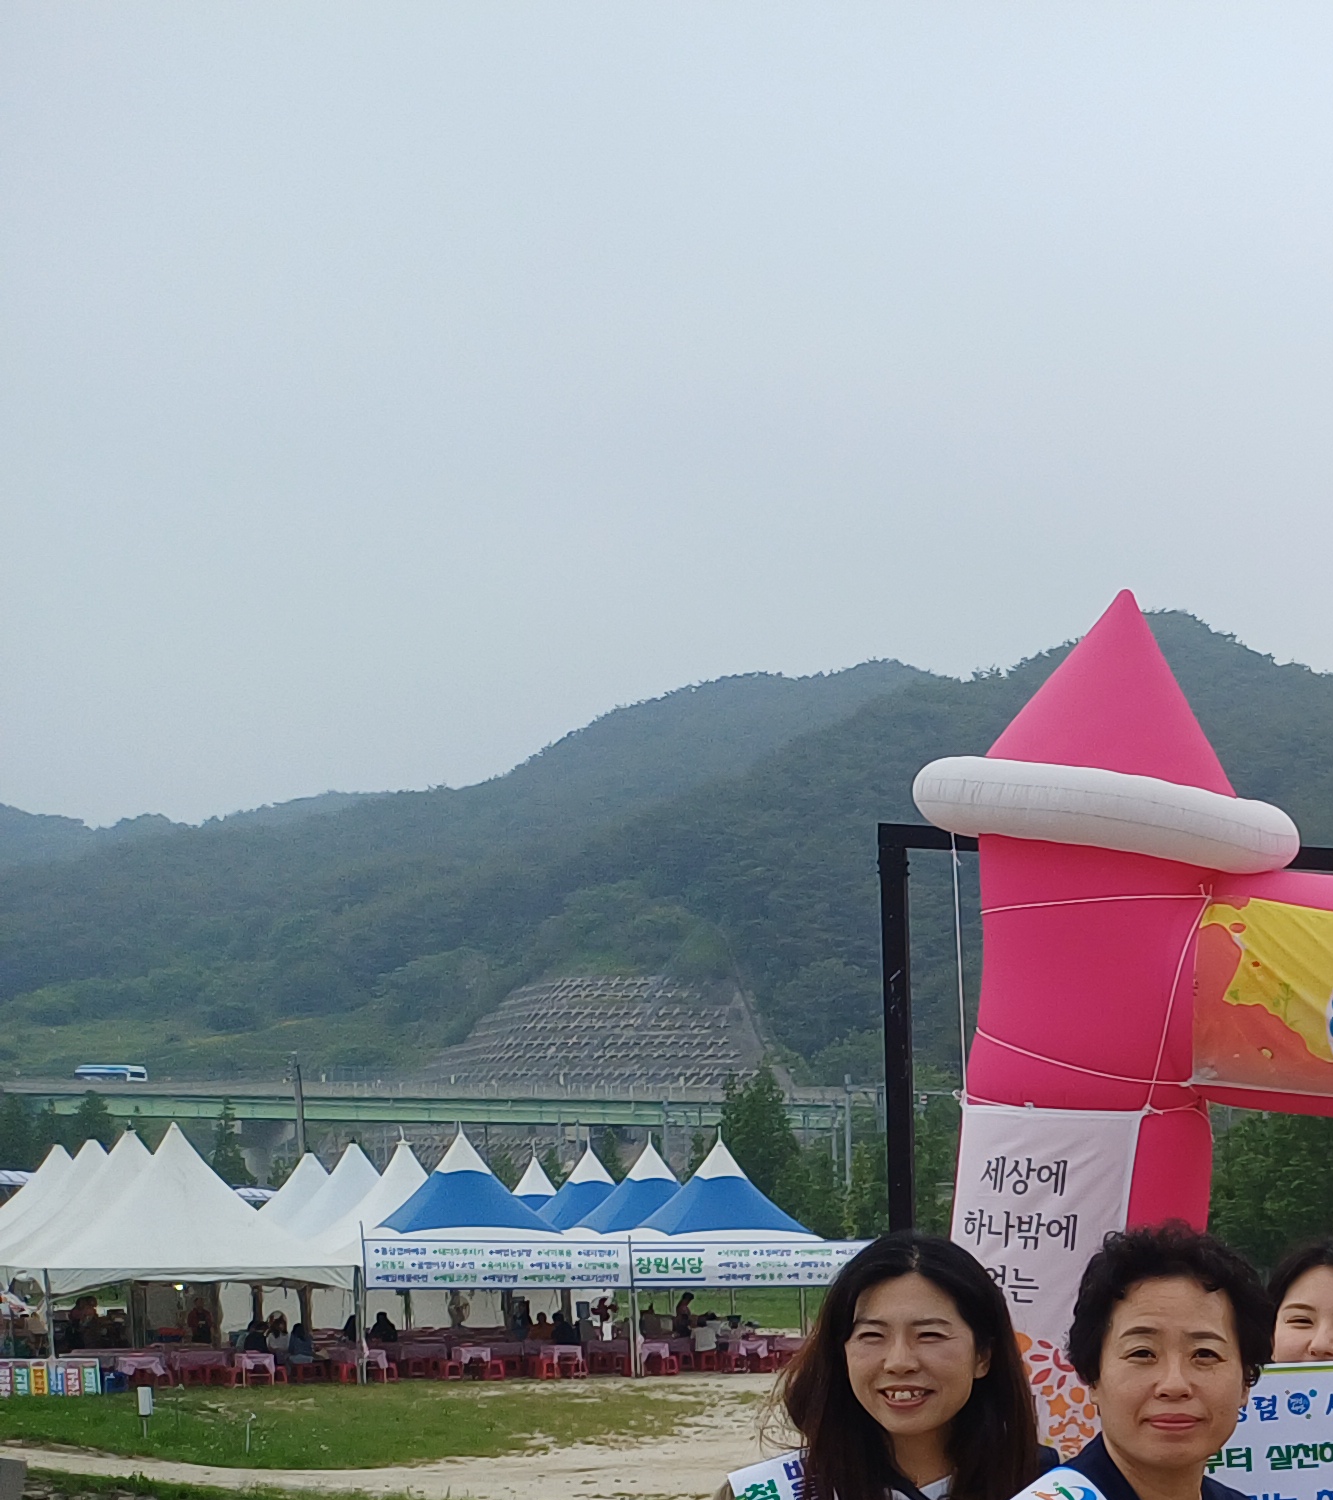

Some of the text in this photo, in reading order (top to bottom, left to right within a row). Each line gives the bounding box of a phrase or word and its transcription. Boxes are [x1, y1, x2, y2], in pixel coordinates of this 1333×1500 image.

[979, 1155, 1069, 1197] 세상에
[963, 1208, 1078, 1252] 하나밖에
[634, 1255, 704, 1275] 창원식당
